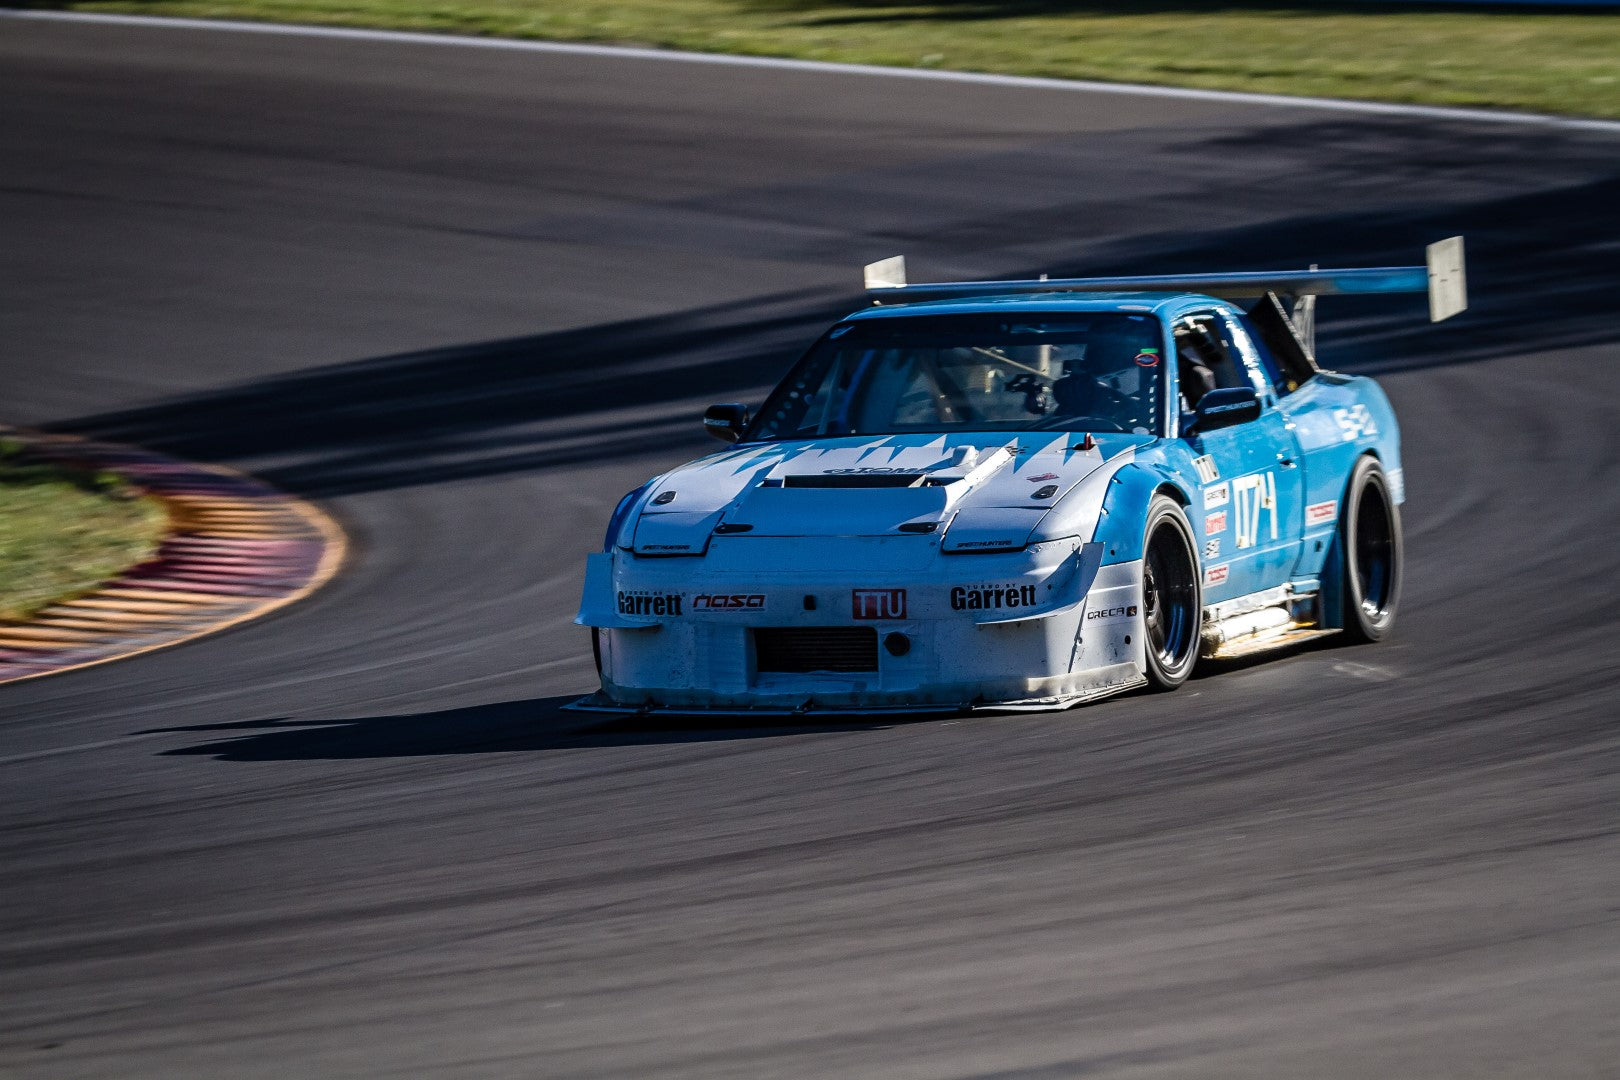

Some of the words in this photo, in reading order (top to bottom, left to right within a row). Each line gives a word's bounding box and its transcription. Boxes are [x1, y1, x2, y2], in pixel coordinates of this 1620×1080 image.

[1232, 471, 1278, 549] 074
[618, 591, 683, 616] Garrett
[855, 591, 903, 617] TTU
[951, 584, 1036, 611] Garrett
